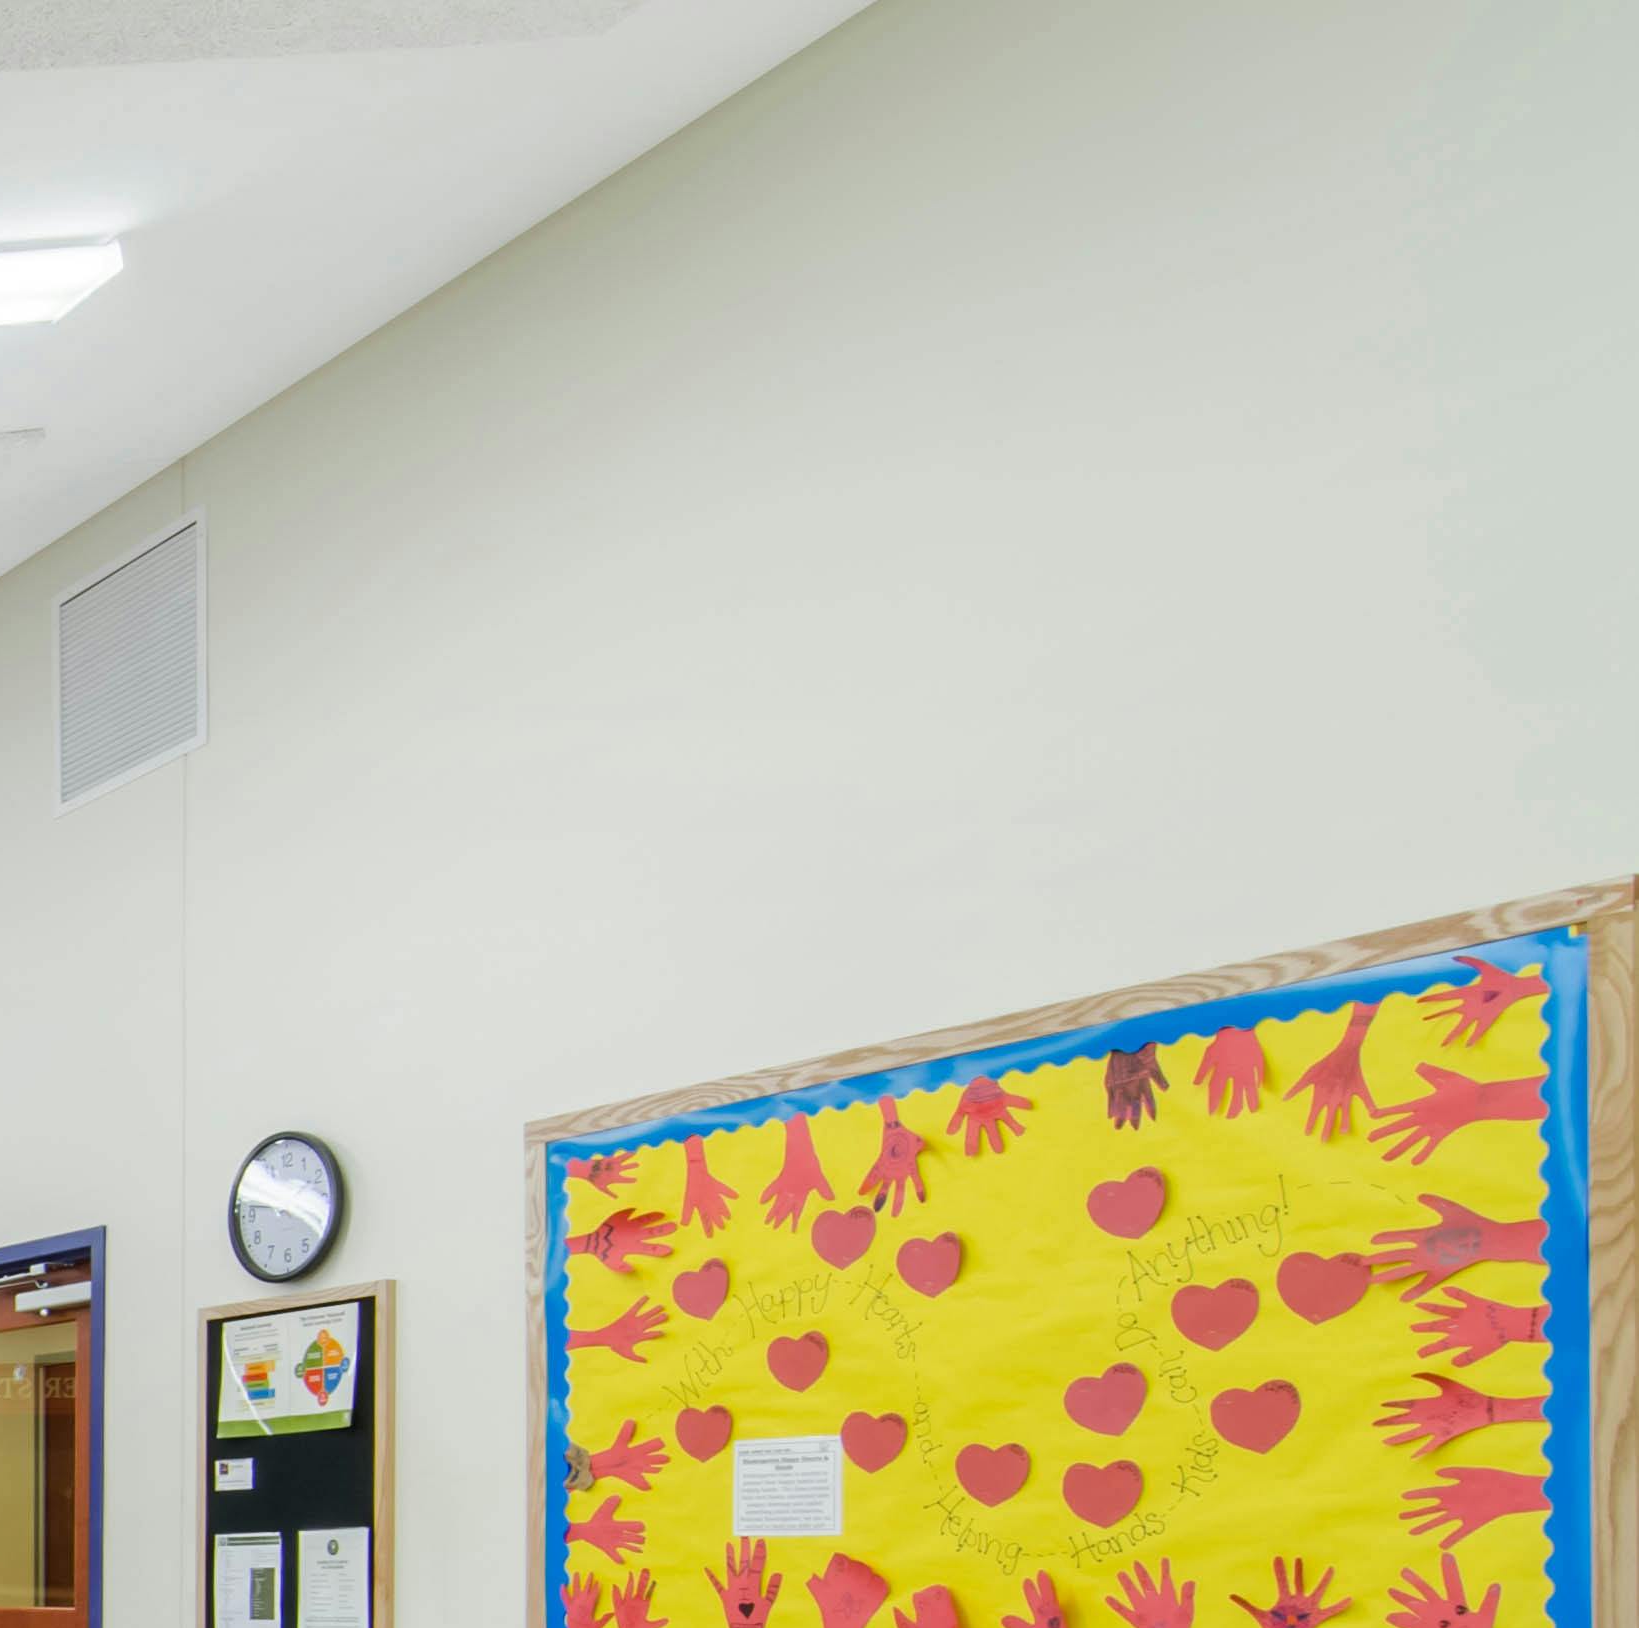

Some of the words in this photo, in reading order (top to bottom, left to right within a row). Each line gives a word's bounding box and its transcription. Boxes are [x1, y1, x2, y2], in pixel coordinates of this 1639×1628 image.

[281, 1152, 294, 1168] 12
[302, 1157, 307, 1171] 1
[314, 1168, 324, 1184] 2
[248, 1207, 256, 1223] 9
[253, 1230, 262, 1245] 8
[267, 1244, 275, 1260] 7
[283, 1247, 293, 1263] 6
[301, 1238, 310, 1254] 5
[1127, 1174, 1290, 1302] Anything!
[733, 1272, 833, 1338] Happy
[849, 1264, 923, 1360] Hearts
[1114, 1311, 1157, 1352] Do
[662, 1341, 725, 1409] With
[913, 1402, 944, 1464] and
[1171, 1434, 1219, 1497] Kids
[923, 1485, 1023, 1576] Helping
[1068, 1512, 1166, 1568] Hands
